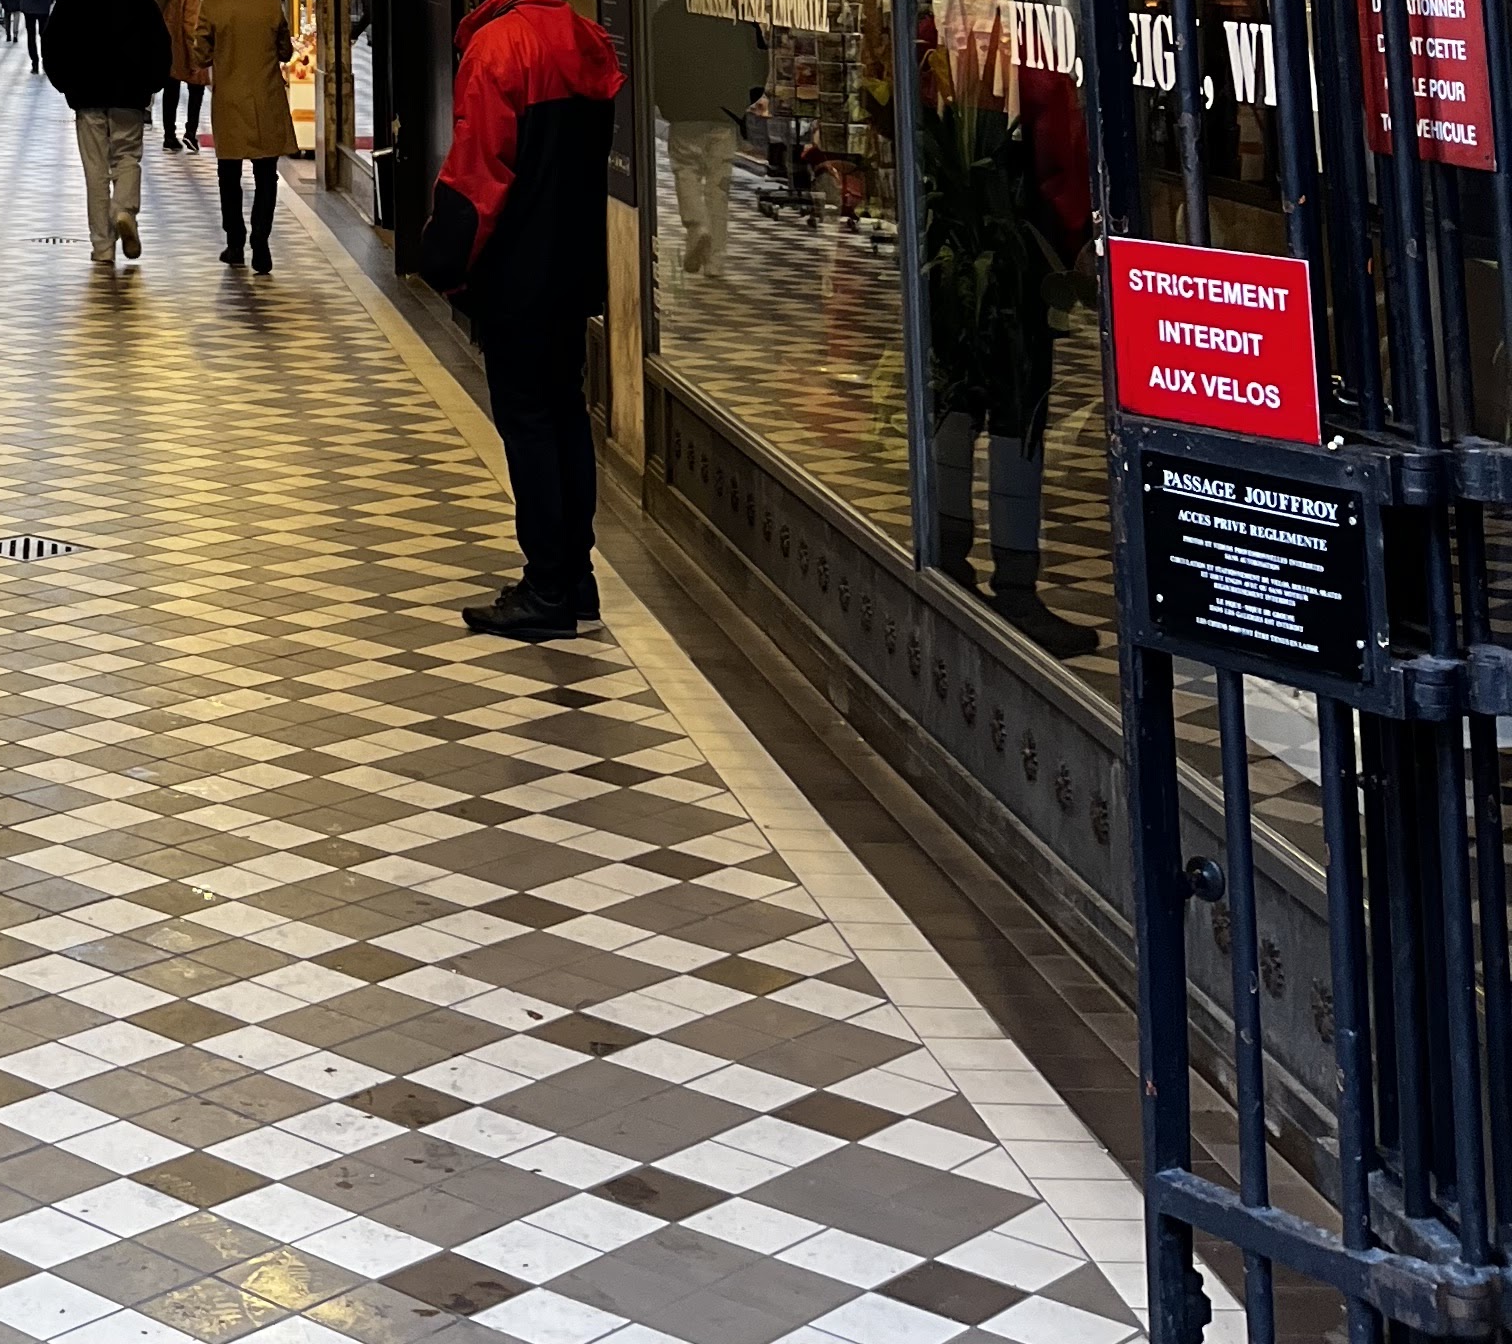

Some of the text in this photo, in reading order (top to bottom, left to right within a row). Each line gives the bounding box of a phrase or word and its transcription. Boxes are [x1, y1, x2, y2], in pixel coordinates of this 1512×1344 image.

[1007, 0, 1084, 88] FIND,
[1426, 38, 1467, 60] CETTE
[1429, 79, 1466, 101] POUR
[1416, 118, 1478, 145] VEHICULE
[1129, 268, 1289, 311] STRICTEMENT
[1158, 320, 1263, 357] INTERDIT
[1149, 365, 1281, 409] AUX VELOS
[1163, 469, 1339, 521] PASSAGE JOUFFROY
[1178, 510, 1328, 551] ACCES PRIVE REGLEMENTE
